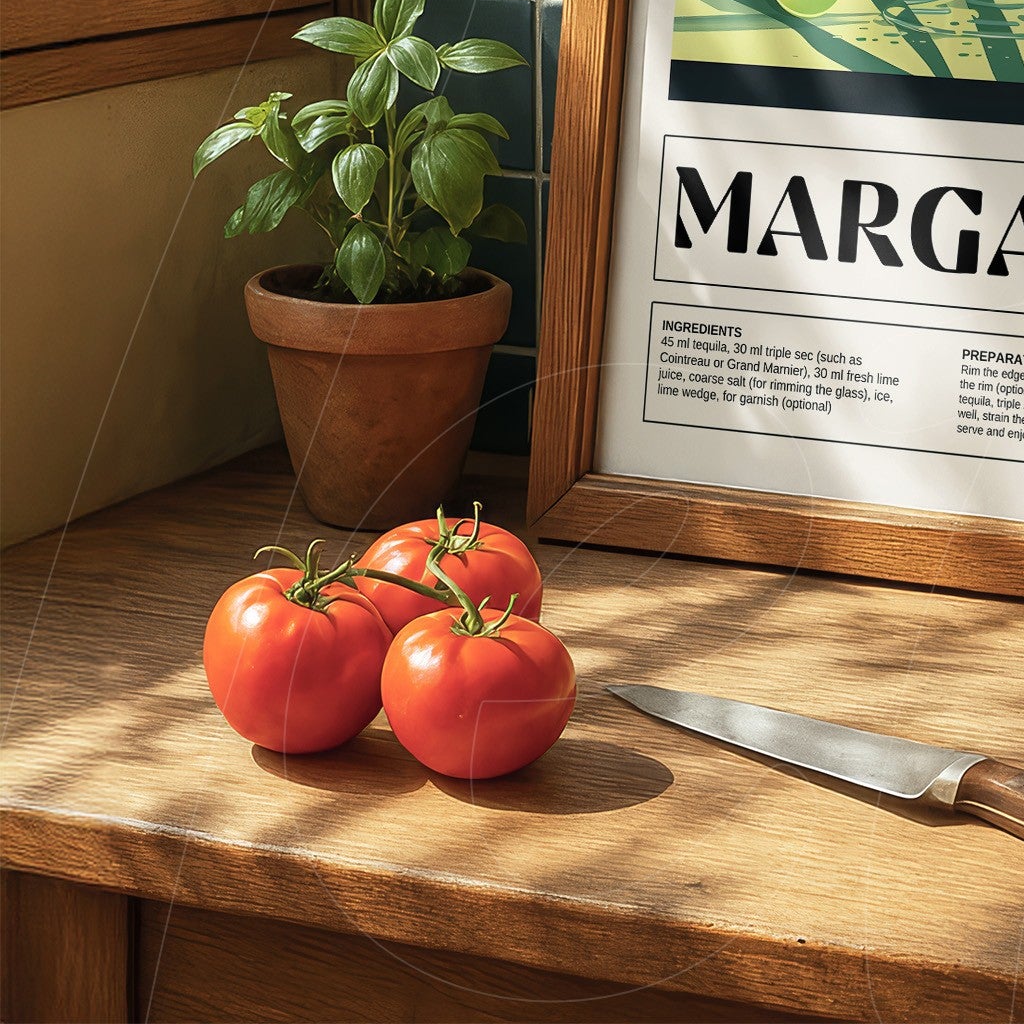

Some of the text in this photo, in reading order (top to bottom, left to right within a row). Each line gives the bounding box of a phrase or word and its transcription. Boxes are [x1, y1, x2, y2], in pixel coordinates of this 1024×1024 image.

[662, 319, 743, 338] INGREDIENTS
[660, 335, 863, 366] 45 ml tequila, 30 ml triple sec (such as
[659, 351, 711, 368] Cointreau
[713, 359, 725, 369] or
[726, 358, 761, 373] Grand
[813, 366, 828, 379] 30
[830, 369, 844, 381] ml
[846, 369, 874, 384] fresh
[876, 372, 900, 387] lime
[960, 364, 981, 376] Rim
[983, 366, 999, 378] the
[657, 367, 686, 384] juice,
[688, 372, 725, 385] coarse
[726, 375, 747, 388] salt
[748, 376, 768, 391] (for
[769, 378, 813, 397] rimming
[815, 383, 833, 397] the
[874, 389, 893, 404] ice,
[959, 378, 976, 391] the
[977, 380, 994, 392] rim
[657, 382, 832, 415] lime wedge, for garnish (optional)
[958, 394, 994, 409] tequila,
[996, 397, 1022, 411] triple
[957, 408, 980, 422] well,
[982, 411, 1010, 424] strain
[956, 424, 984, 436] serve
[985, 427, 1006, 438] and
